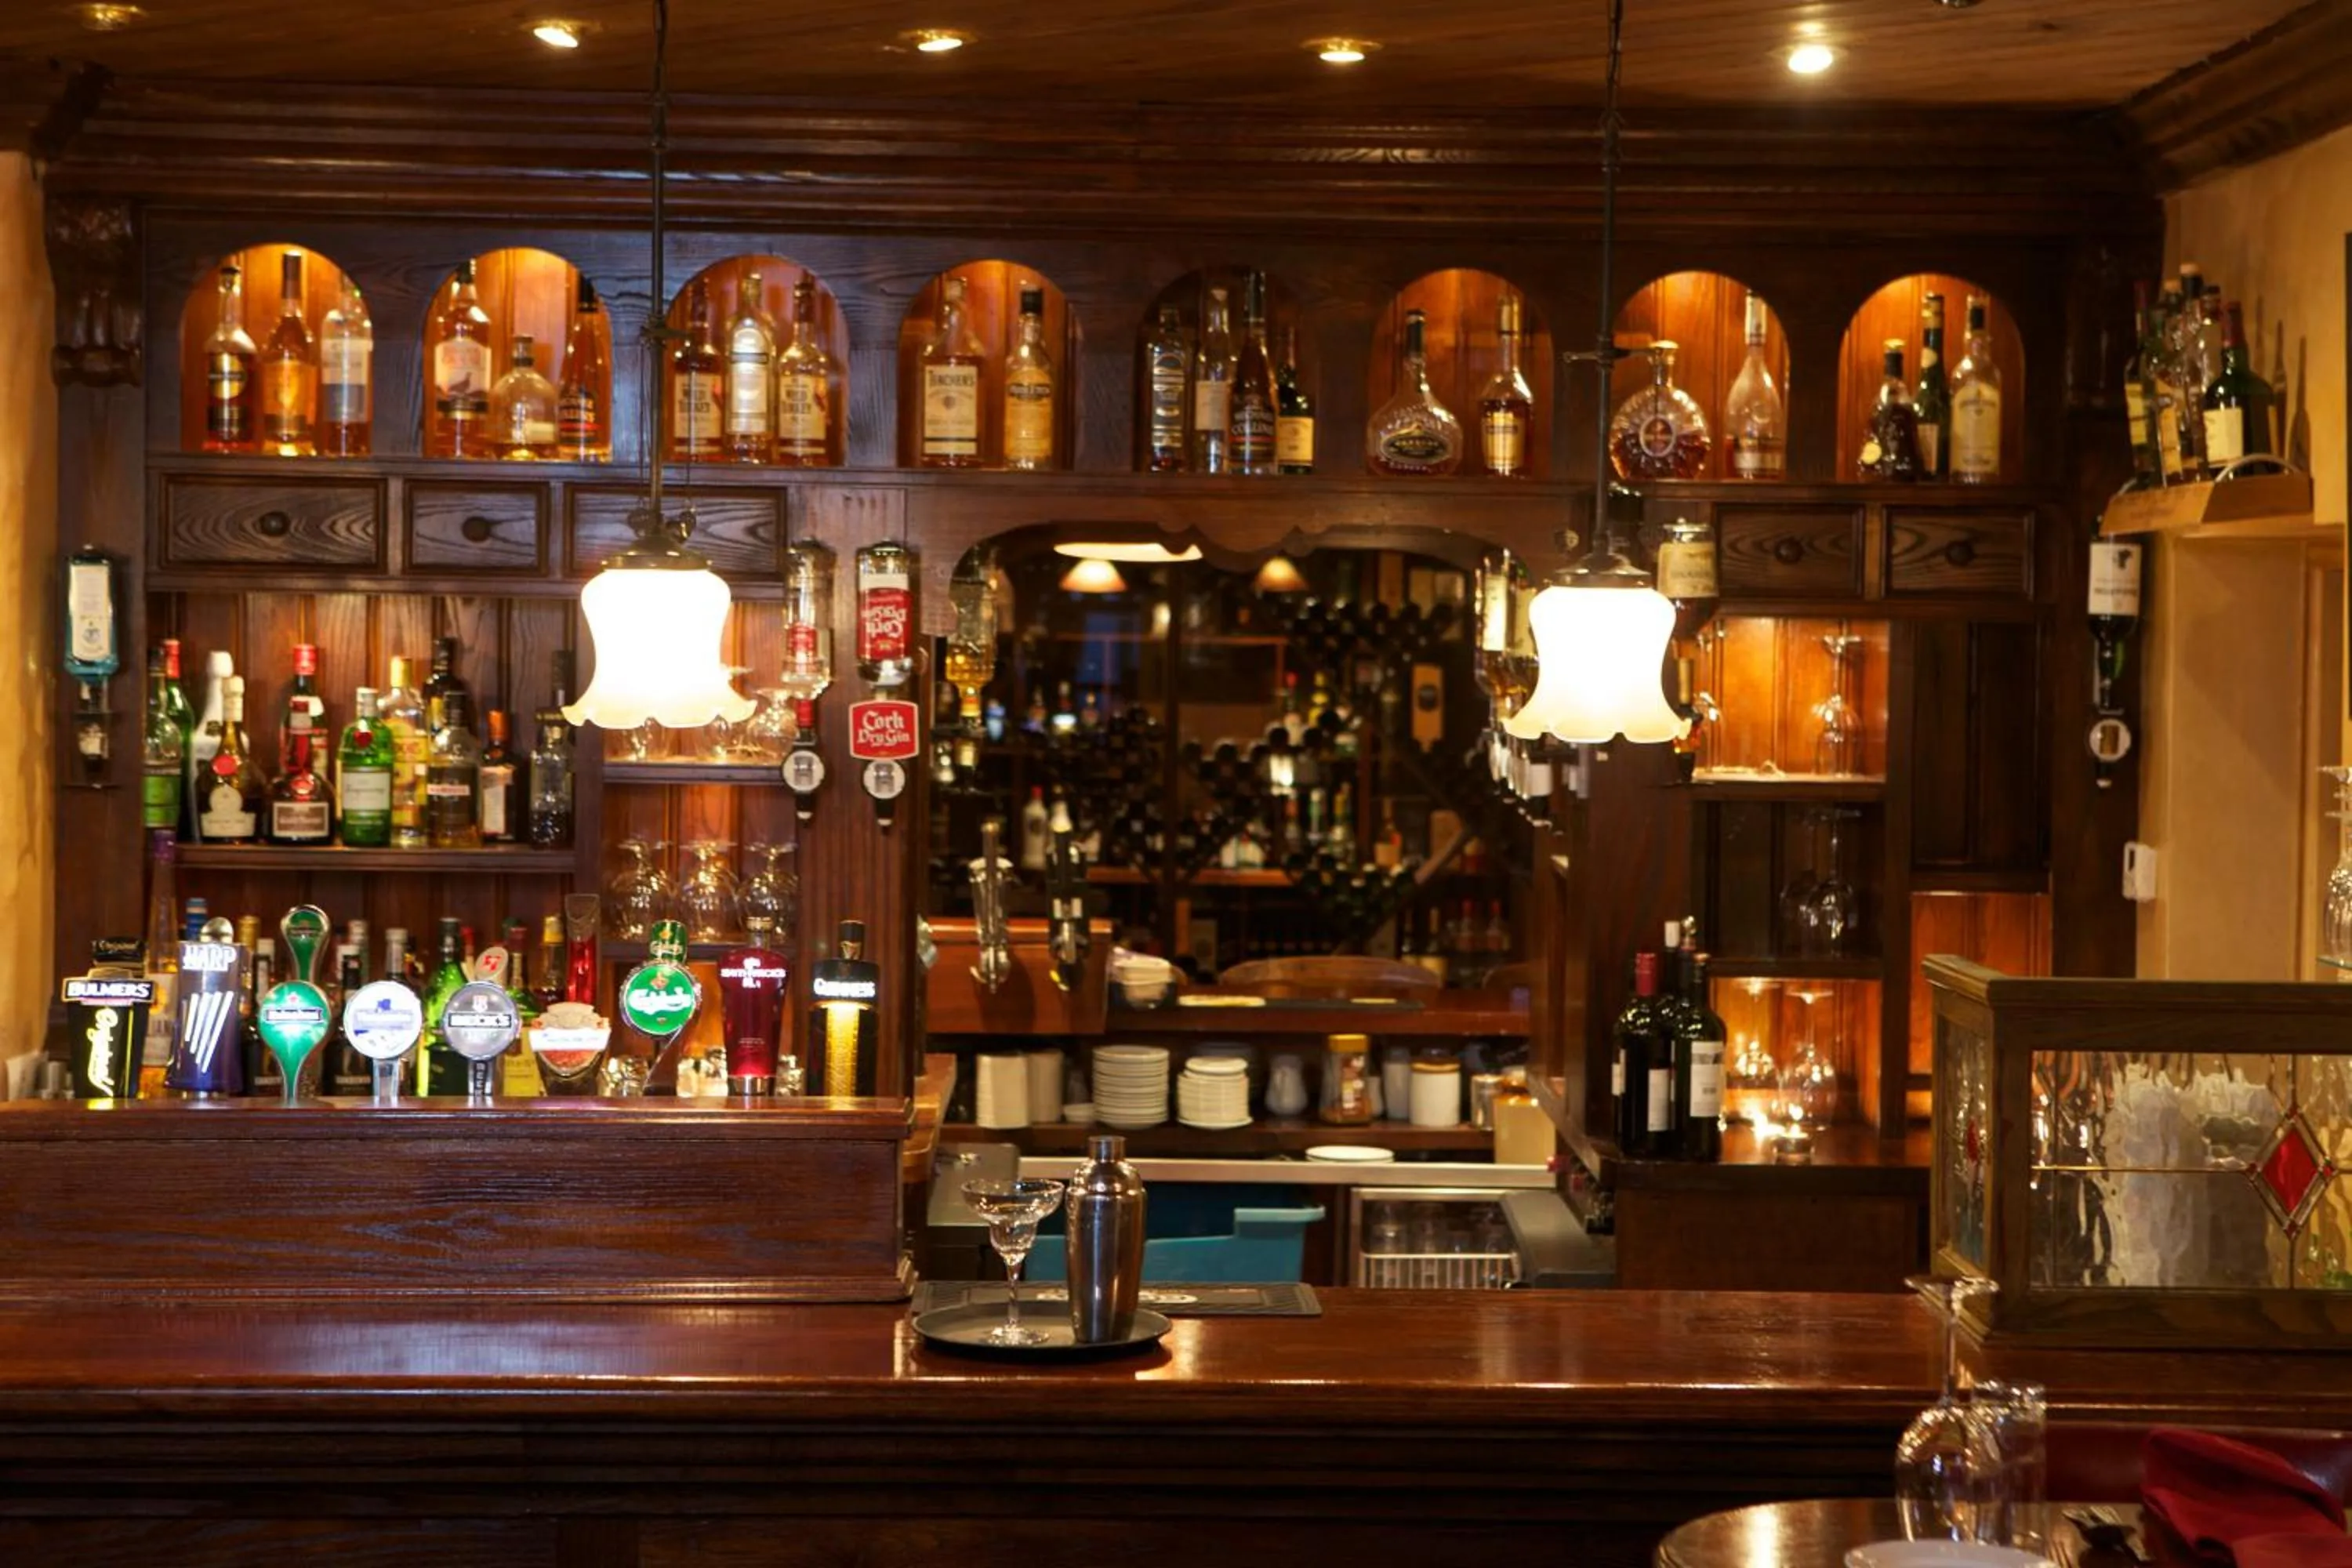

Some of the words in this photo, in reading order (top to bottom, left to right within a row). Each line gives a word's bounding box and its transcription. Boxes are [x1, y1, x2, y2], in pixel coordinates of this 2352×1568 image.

[862, 710, 905, 732] Cork
[856, 728, 884, 748] Dry
[884, 728, 911, 747] Gin
[182, 943, 238, 971] HARP
[67, 982, 152, 998] BULMERS
